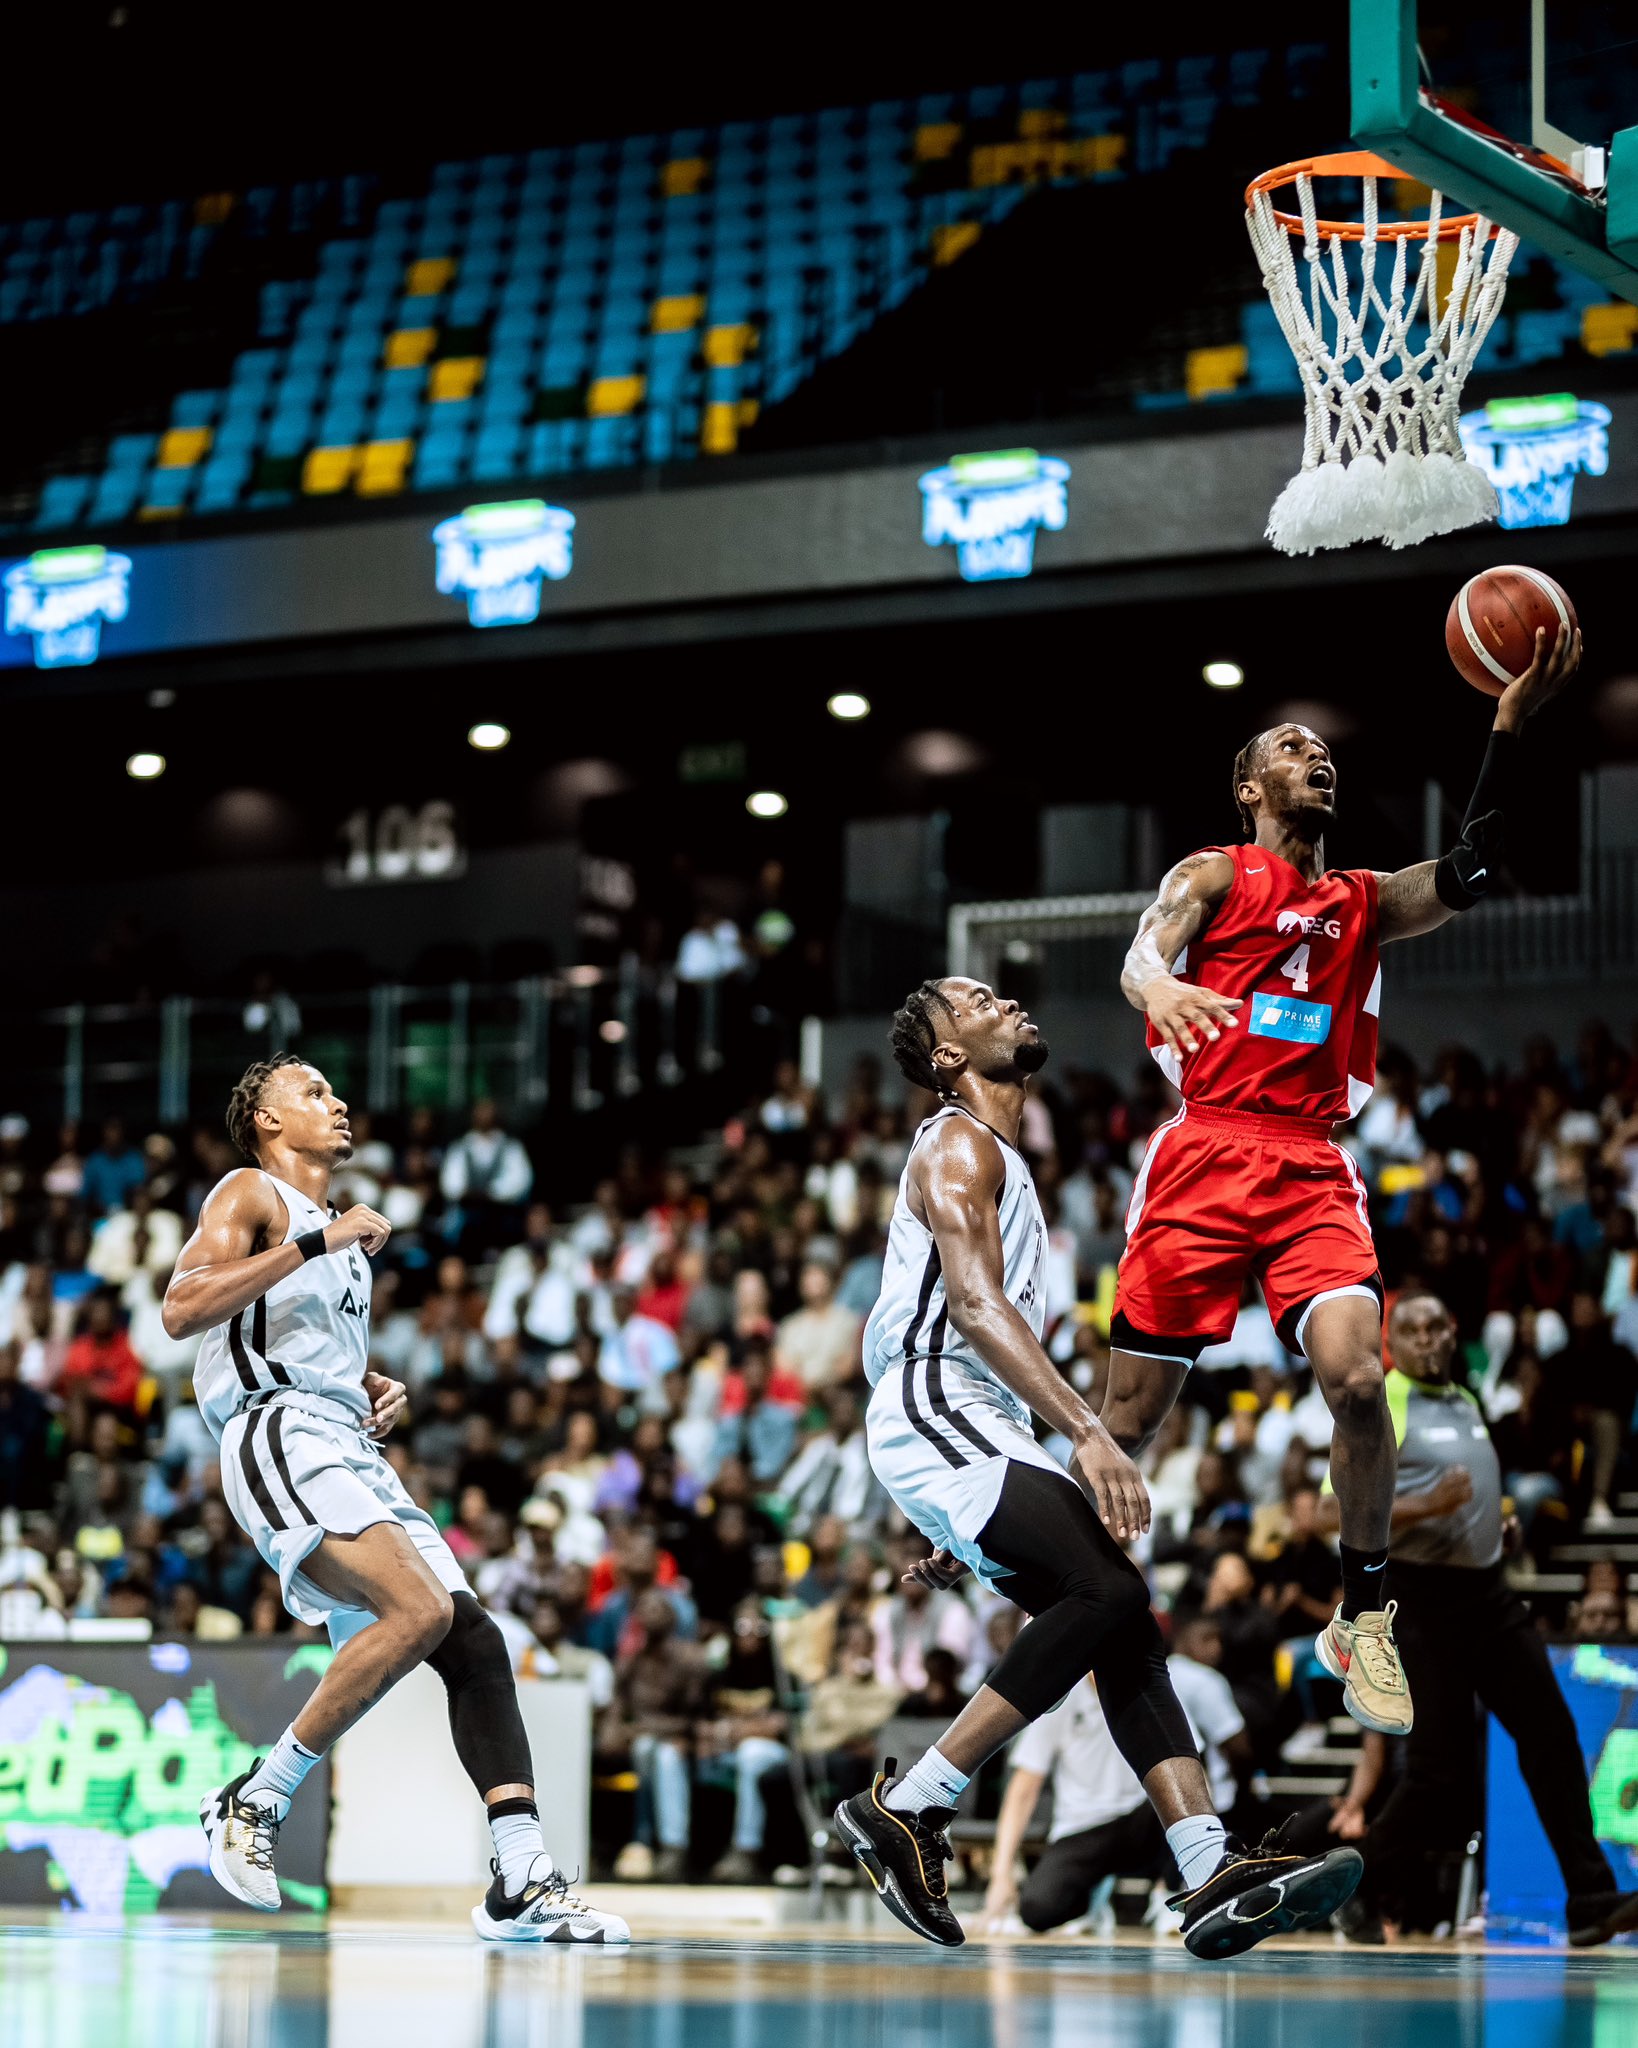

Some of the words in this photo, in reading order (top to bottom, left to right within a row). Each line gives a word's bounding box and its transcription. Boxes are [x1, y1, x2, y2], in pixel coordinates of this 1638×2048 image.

[341, 801, 458, 880] 106
[1280, 943, 1311, 992] 4
[1284, 1010, 1321, 1024] PRIME
